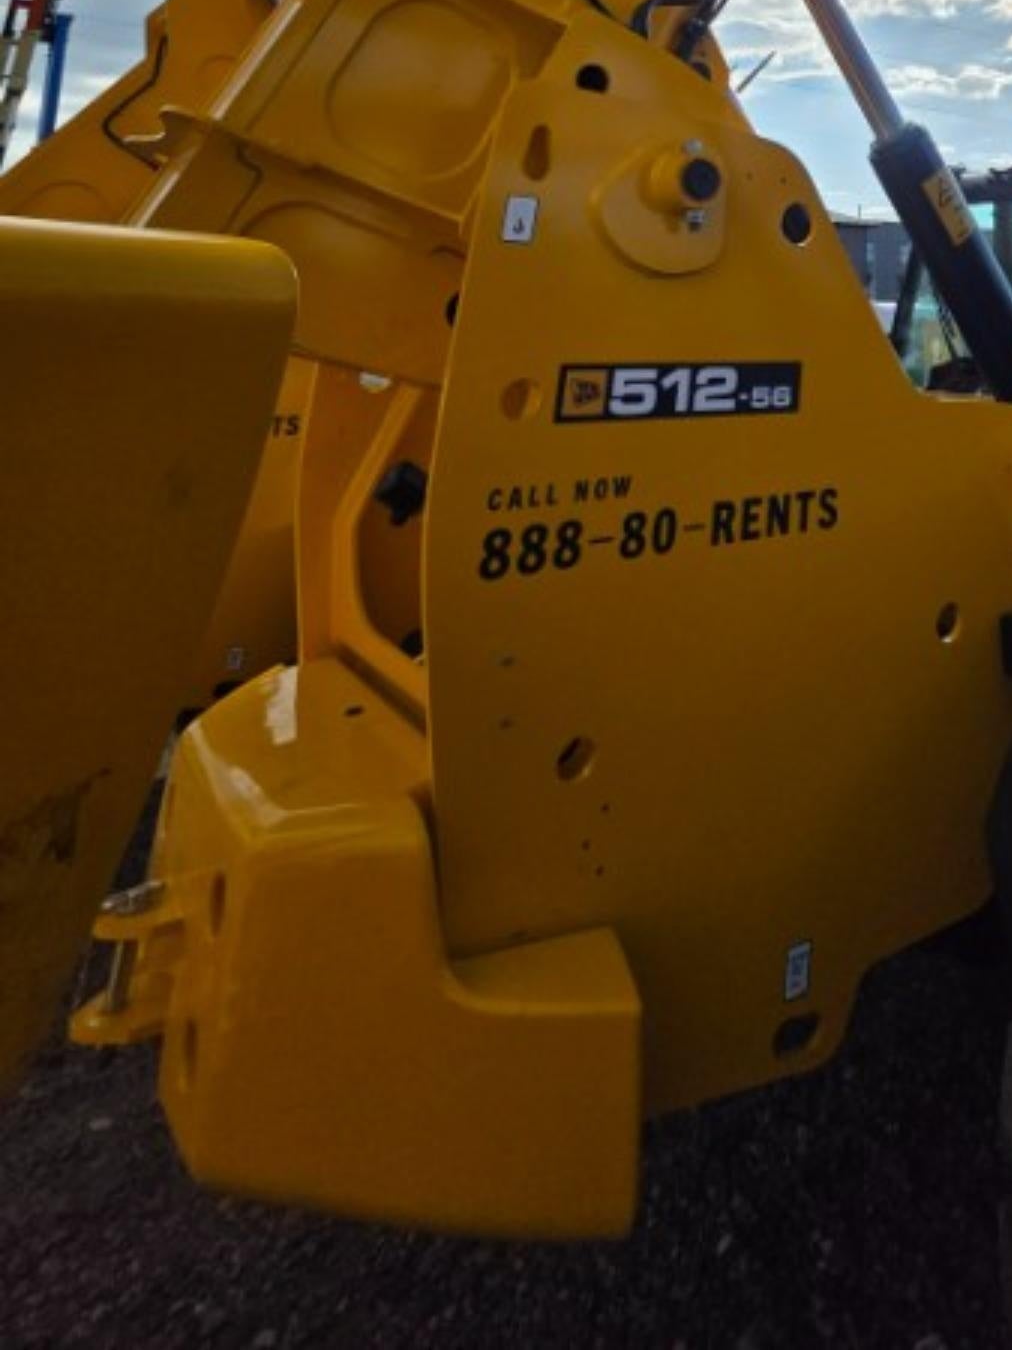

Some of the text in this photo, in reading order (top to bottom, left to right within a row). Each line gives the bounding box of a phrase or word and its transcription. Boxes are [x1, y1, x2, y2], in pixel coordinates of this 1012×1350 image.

[487, 475, 634, 512] CALL NOW
[478, 488, 839, 581] 888-80-RENTS
